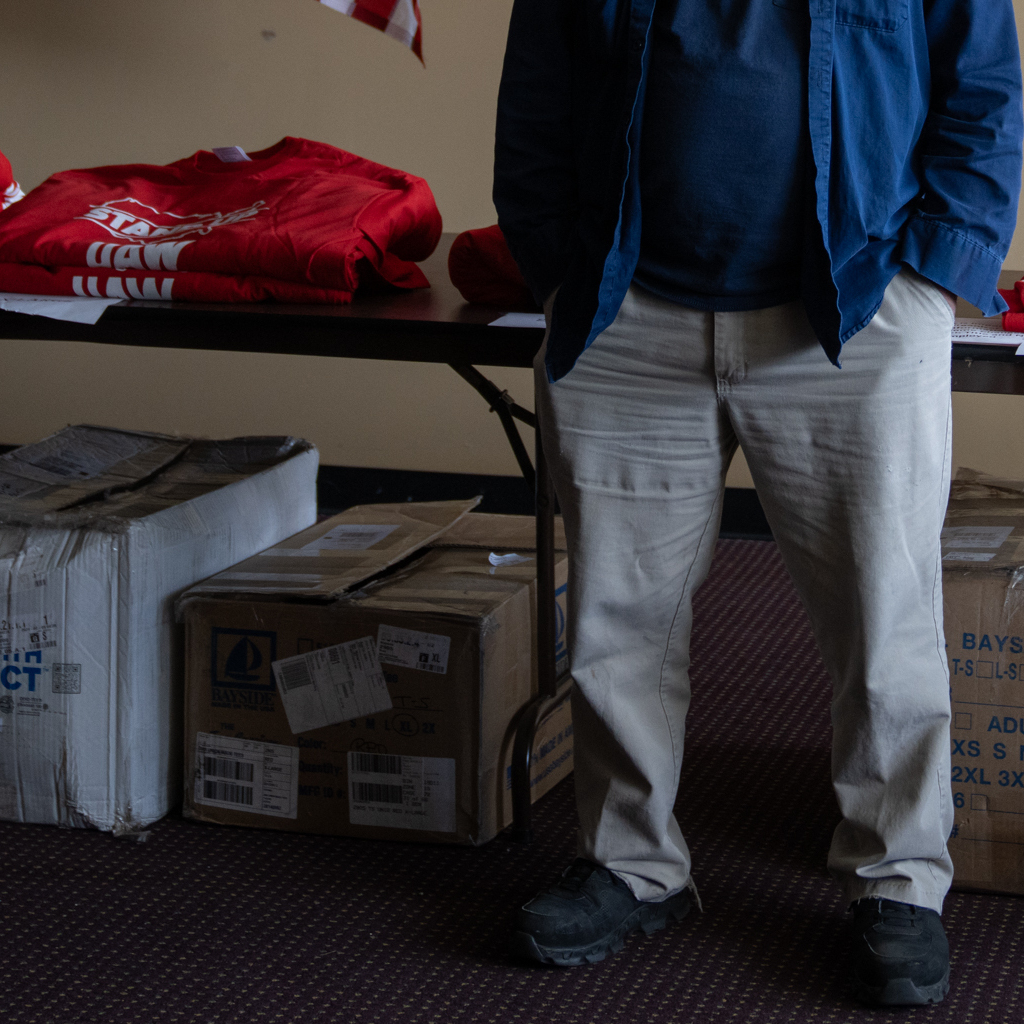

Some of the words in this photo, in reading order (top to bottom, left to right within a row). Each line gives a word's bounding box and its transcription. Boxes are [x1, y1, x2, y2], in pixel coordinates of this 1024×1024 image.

[86, 239, 197, 271] UAW
[431, 653, 441, 663] XL
[952, 658, 974, 677] T-S
[995, 661, 1017, 680] L-S
[211, 687, 276, 706] BAYSIDE
[220, 722, 235, 731] THE
[385, 720, 391, 731] L
[399, 721, 413, 733] XL
[422, 722, 436, 735] 2X
[297, 737, 327, 750] Color:
[951, 738, 981, 757] XS
[992, 742, 1007, 760] S
[298, 760, 343, 776] Quantity:
[951, 765, 991, 785] 2XL
[298, 784, 320, 797] MFG
[323, 786, 334, 798] ID
